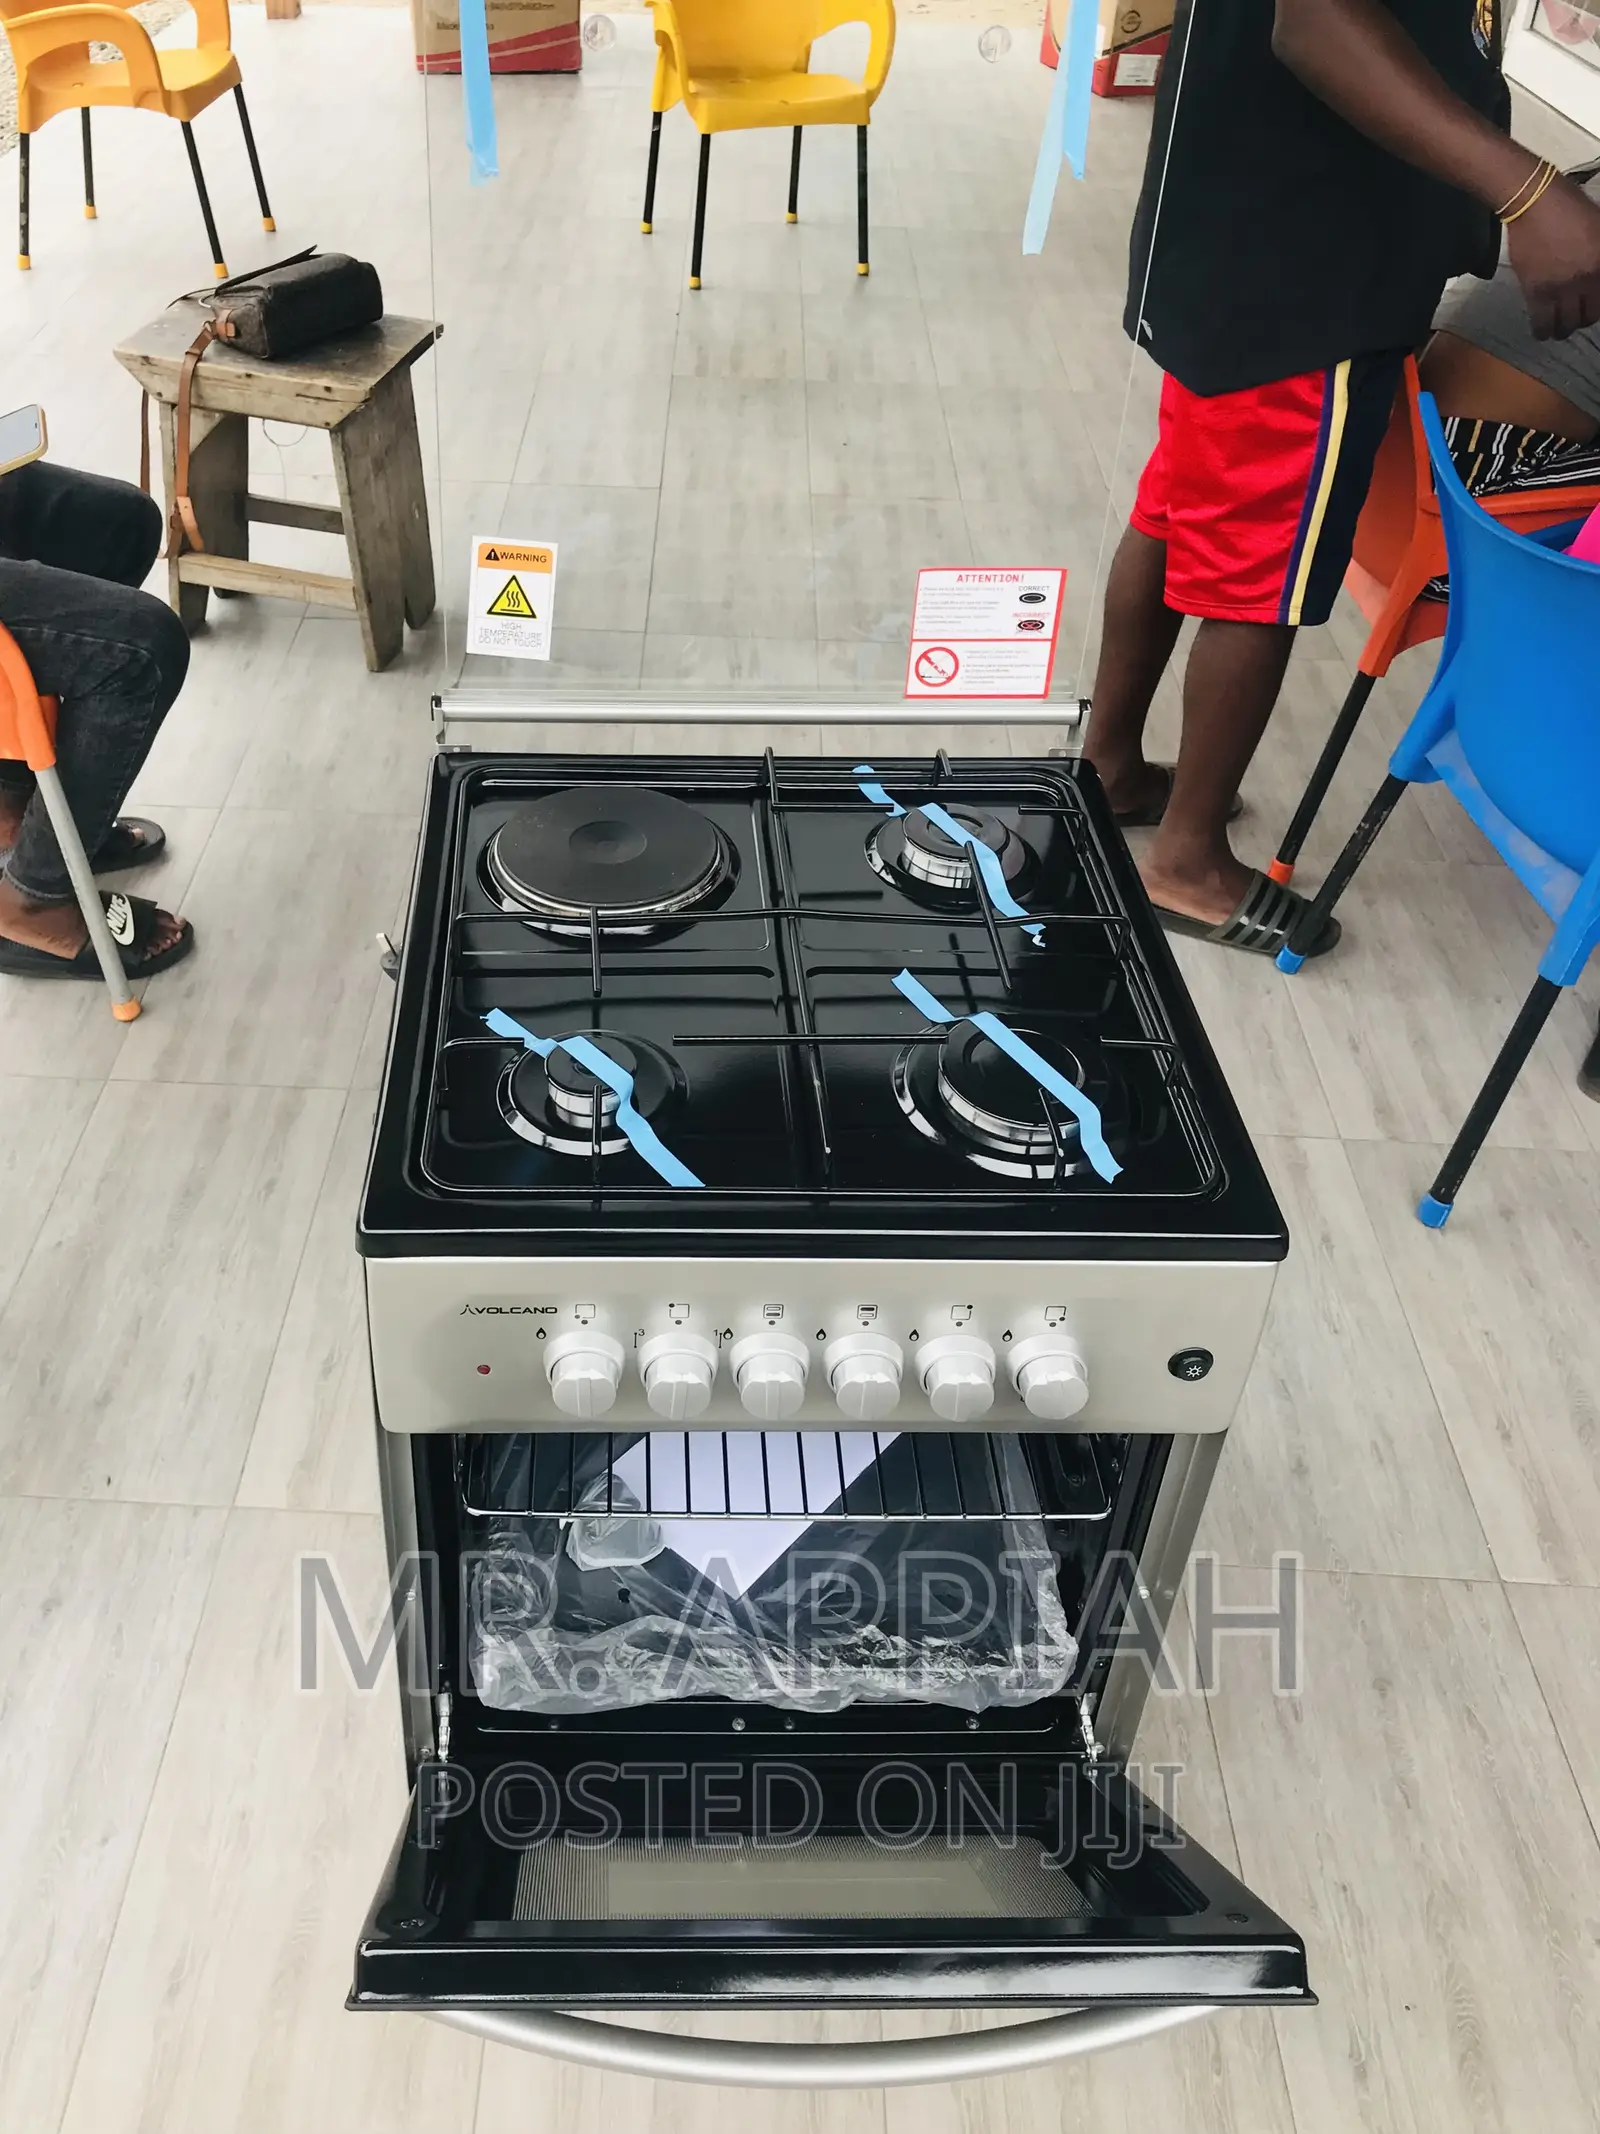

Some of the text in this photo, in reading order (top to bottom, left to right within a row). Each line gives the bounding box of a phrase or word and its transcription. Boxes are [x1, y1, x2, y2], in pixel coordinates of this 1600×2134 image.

[500, 552, 547, 563] WARNING
[956, 573, 1025, 584] ATTENTION!
[501, 621, 522, 631] HIGH
[479, 627, 543, 641] TEMPERATURE
[479, 636, 542, 648] DO NOT TOUCH
[106, 893, 127, 935] NIKE
[474, 1306, 558, 1315] VOLCANO
[637, 1328, 645, 1337] 3
